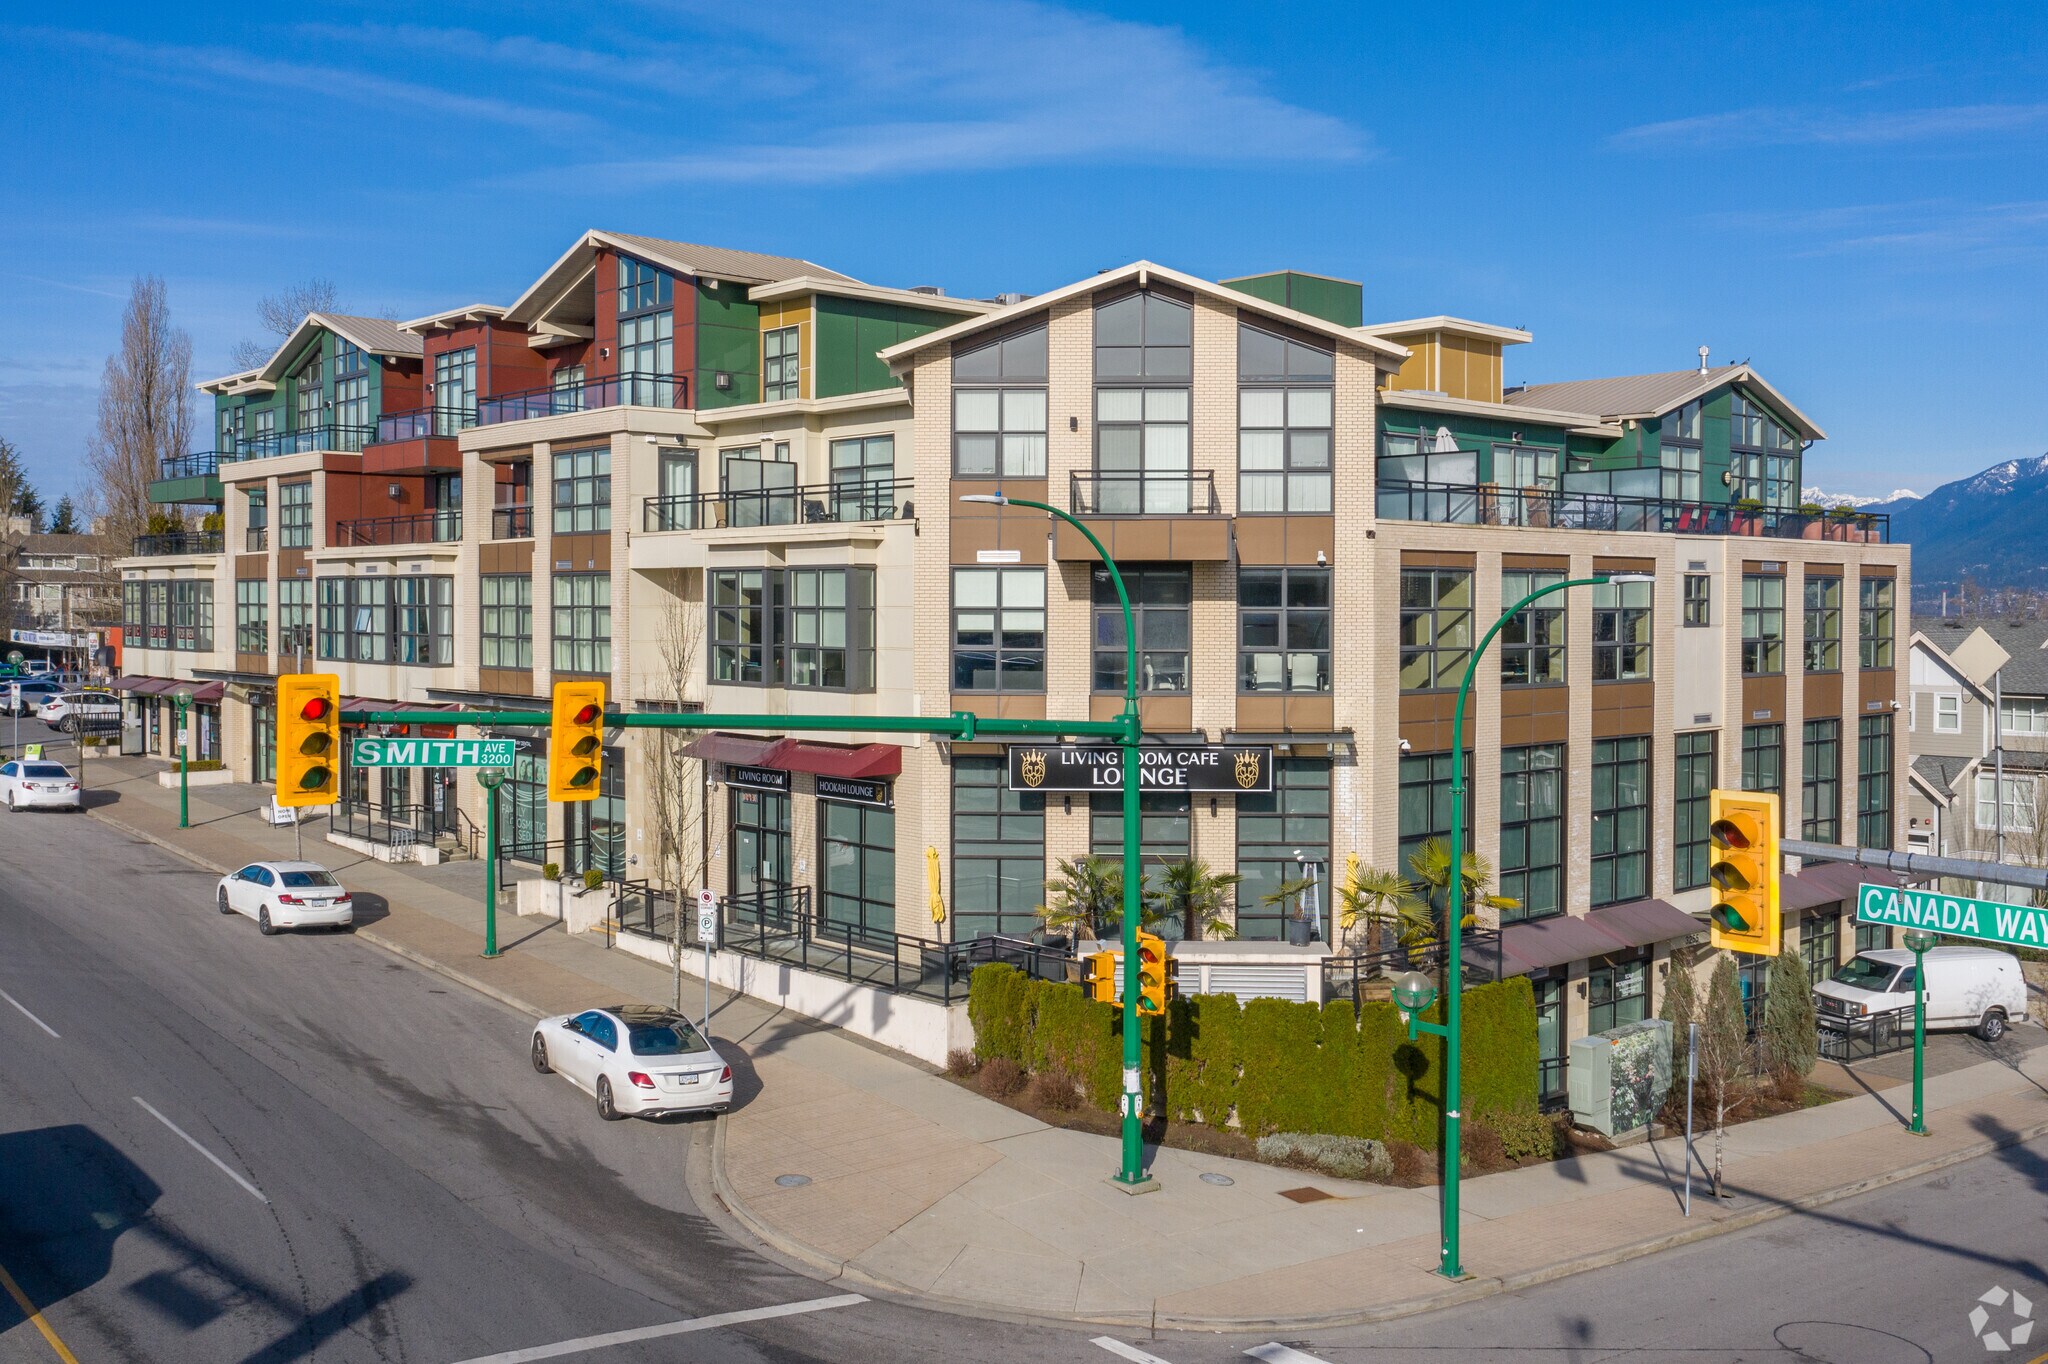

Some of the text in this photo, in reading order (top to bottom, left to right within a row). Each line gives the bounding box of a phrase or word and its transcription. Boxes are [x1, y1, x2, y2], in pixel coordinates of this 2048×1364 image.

[357, 741, 479, 764] SMITH
[484, 743, 506, 753] AVE
[481, 754, 511, 764] 3200
[1061, 751, 1219, 765] LIVING OM CAFE
[738, 770, 783, 785] LIVING ROOM
[1093, 767, 1188, 785] LONGE
[819, 781, 874, 797] HOOKAH LOUNGE
[1864, 888, 2048, 944] CANADA WAY
